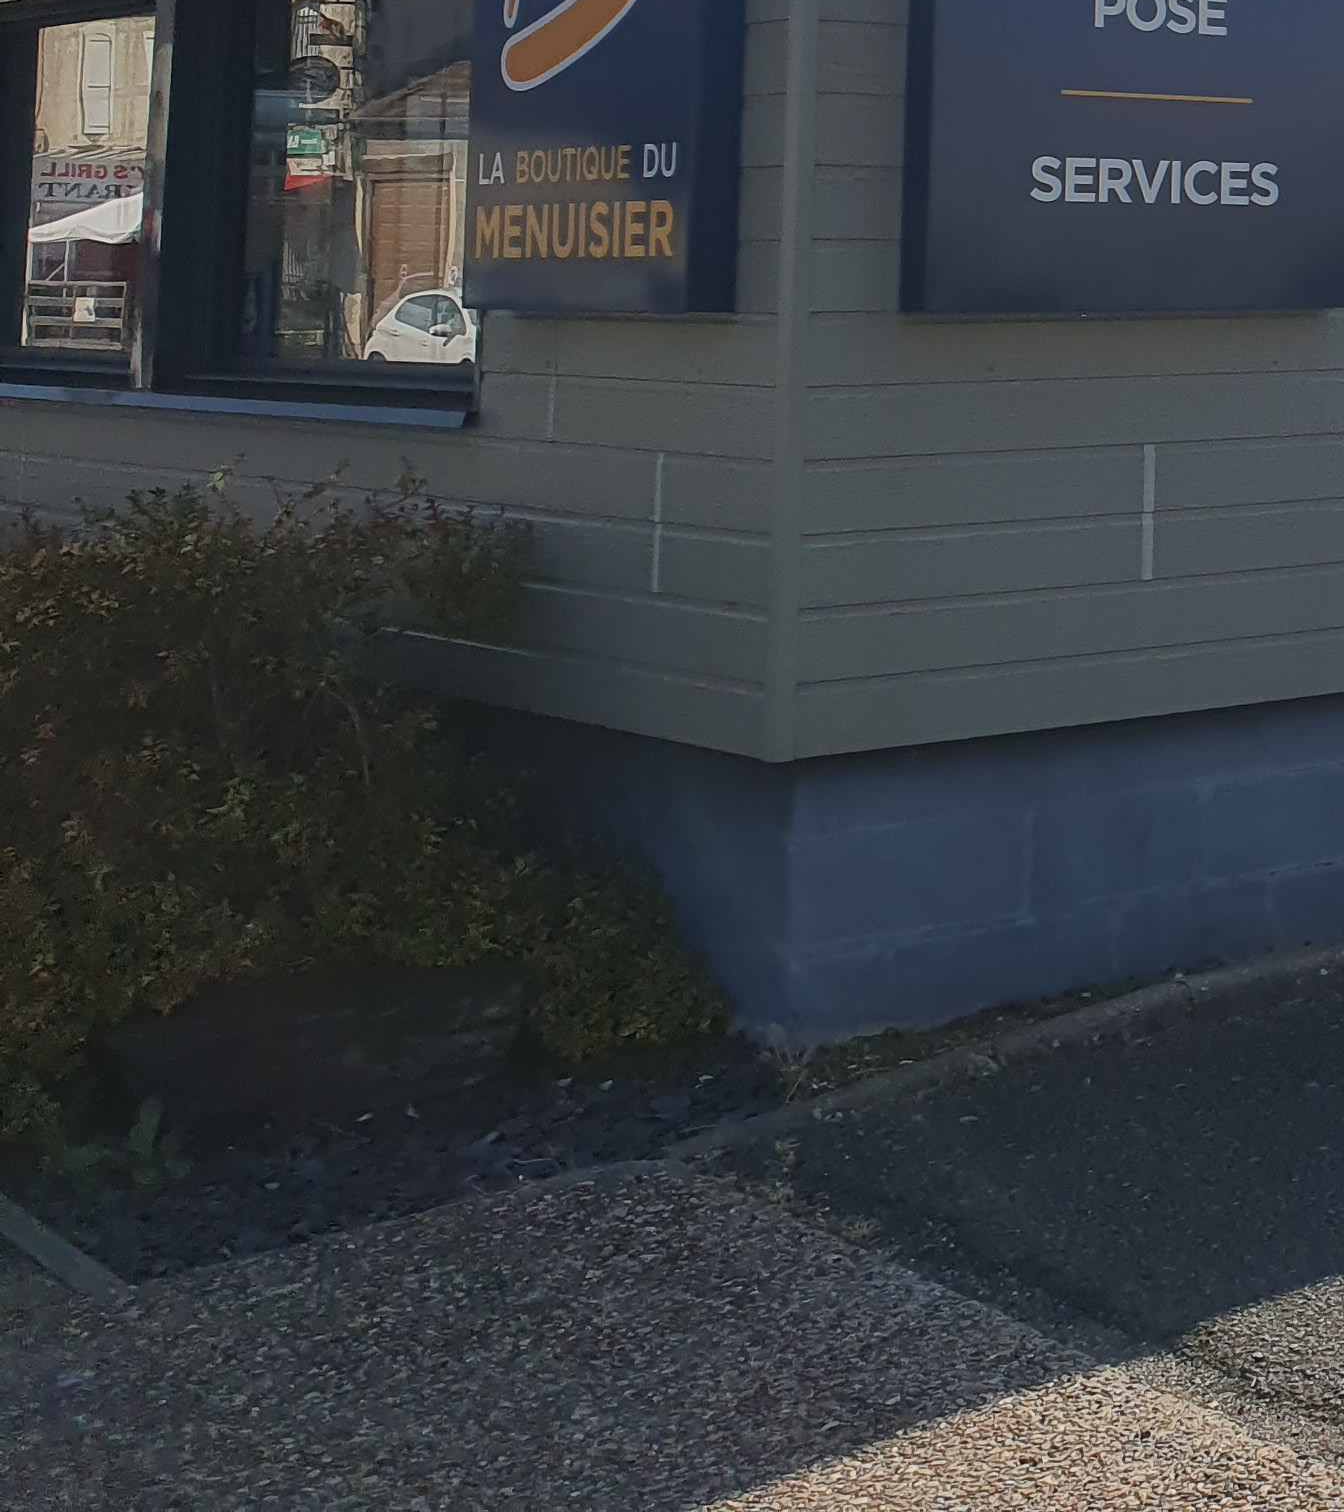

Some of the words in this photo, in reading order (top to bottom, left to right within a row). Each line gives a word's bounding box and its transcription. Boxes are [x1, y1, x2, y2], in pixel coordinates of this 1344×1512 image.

[479, 152, 505, 185] LA
[516, 144, 632, 184] BOUTIQUE
[643, 141, 678, 178] DU
[1030, 155, 1279, 207] SERVICES
[475, 199, 674, 259] MENUISIER
